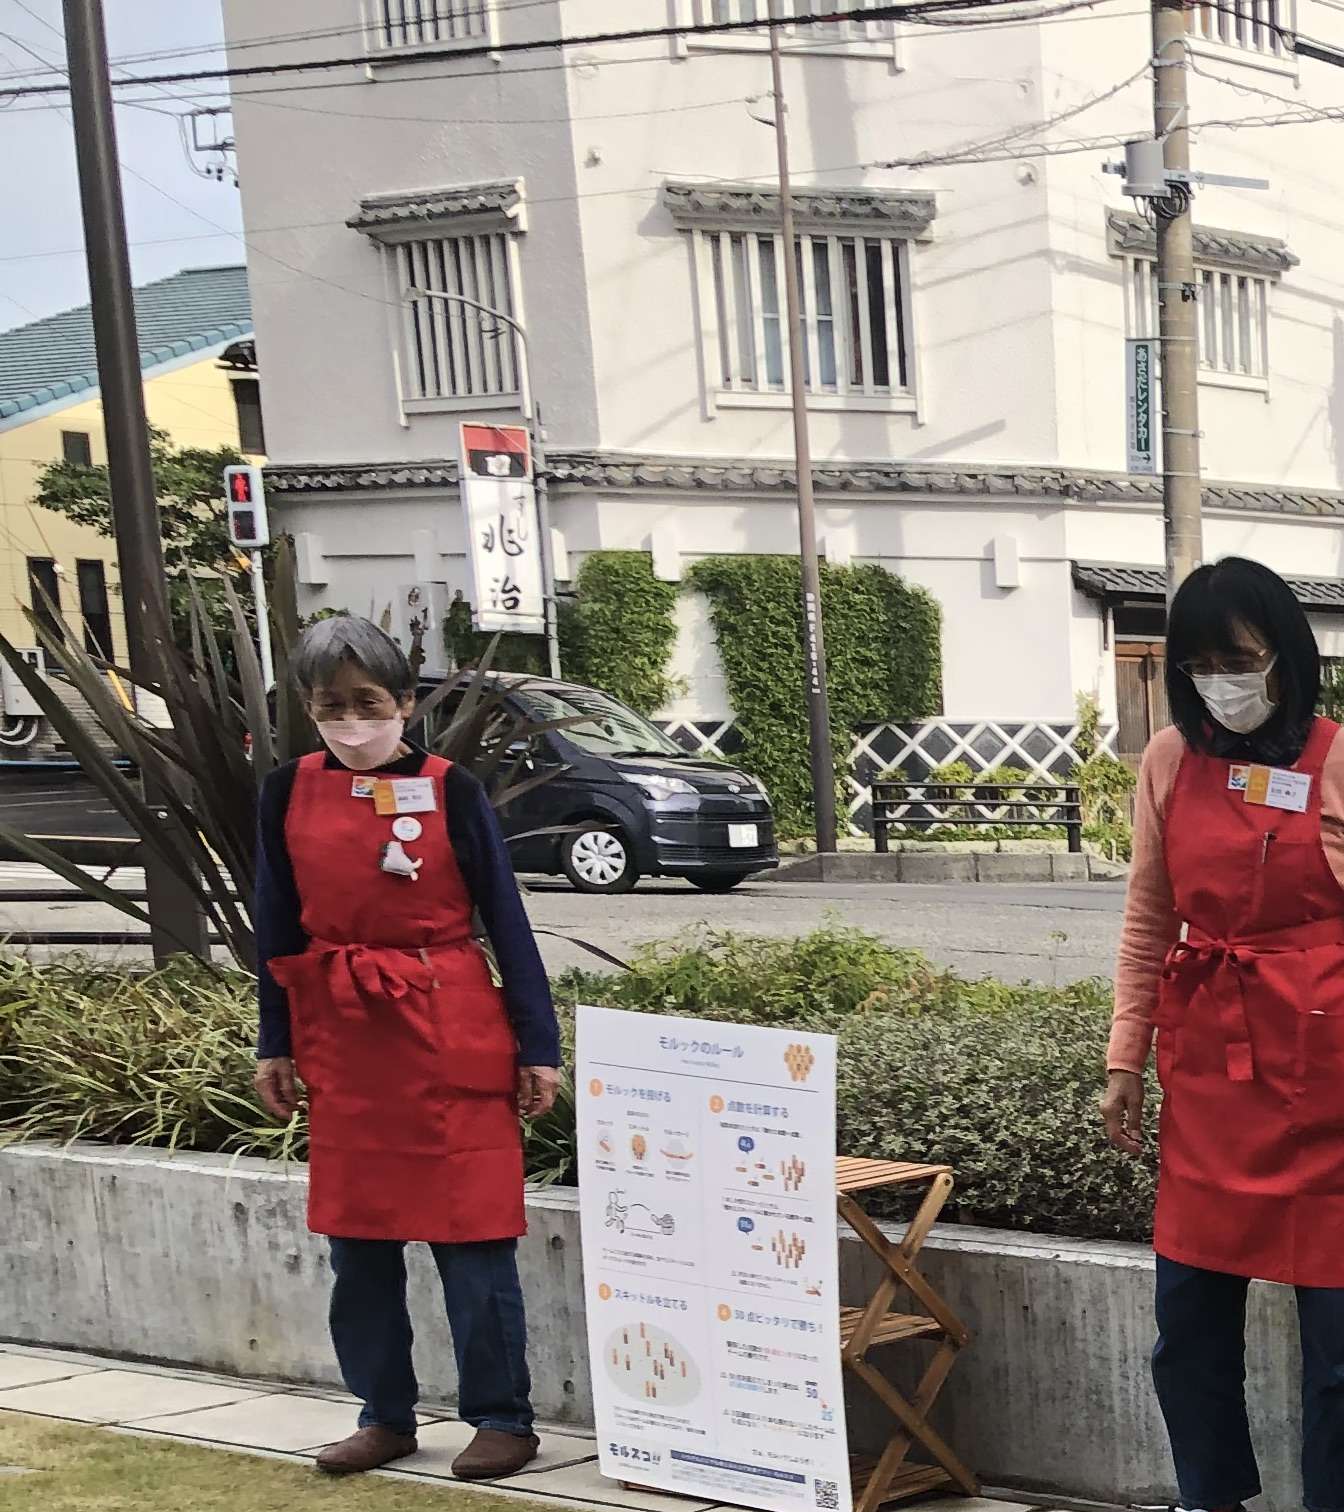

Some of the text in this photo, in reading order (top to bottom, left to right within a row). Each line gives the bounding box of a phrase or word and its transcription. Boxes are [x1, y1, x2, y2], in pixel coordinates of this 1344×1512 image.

[658, 1036, 744, 1059] モルックのルール
